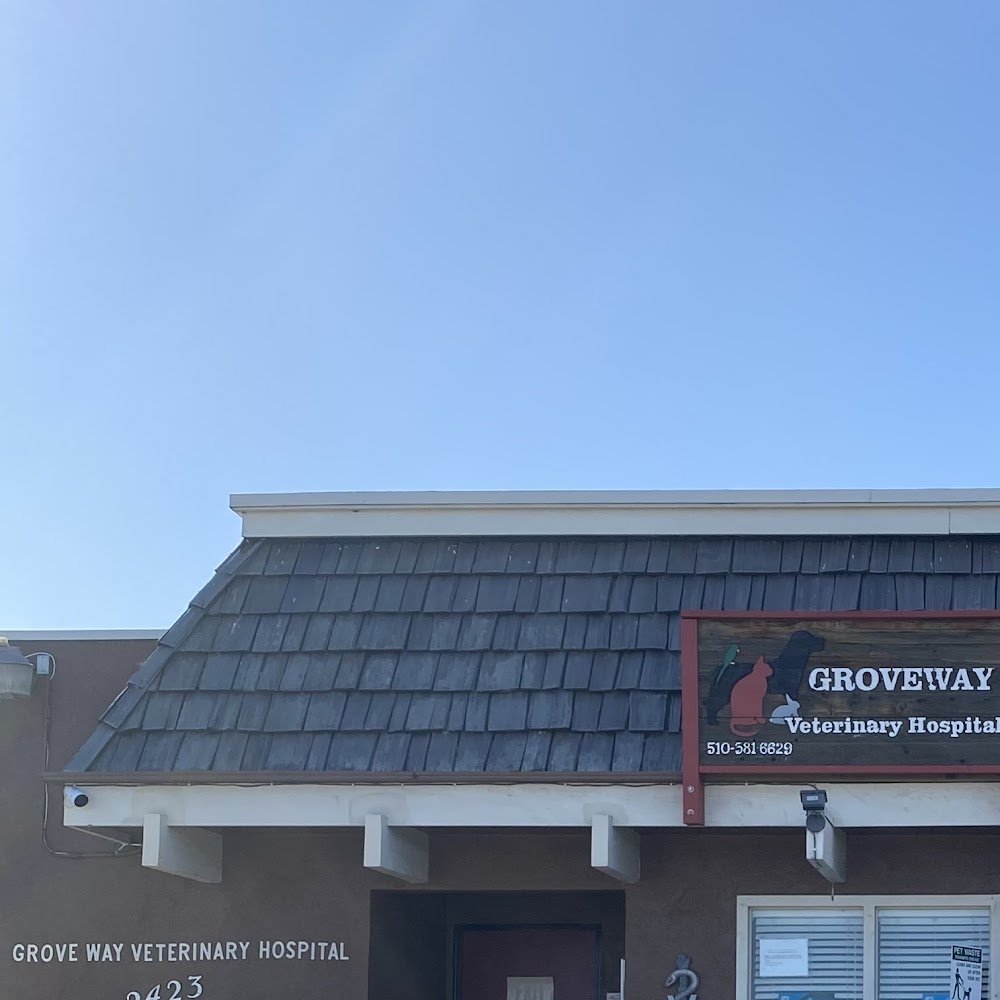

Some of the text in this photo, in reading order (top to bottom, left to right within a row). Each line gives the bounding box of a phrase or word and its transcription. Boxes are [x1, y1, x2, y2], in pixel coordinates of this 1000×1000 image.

[808, 667, 995, 692] GROVEWAY
[784, 717, 903, 737] Veterinary
[12, 941, 349, 962] GROVE WAY VETERINARY HOSPITAL
[954, 947, 980, 956] PET WASTE
